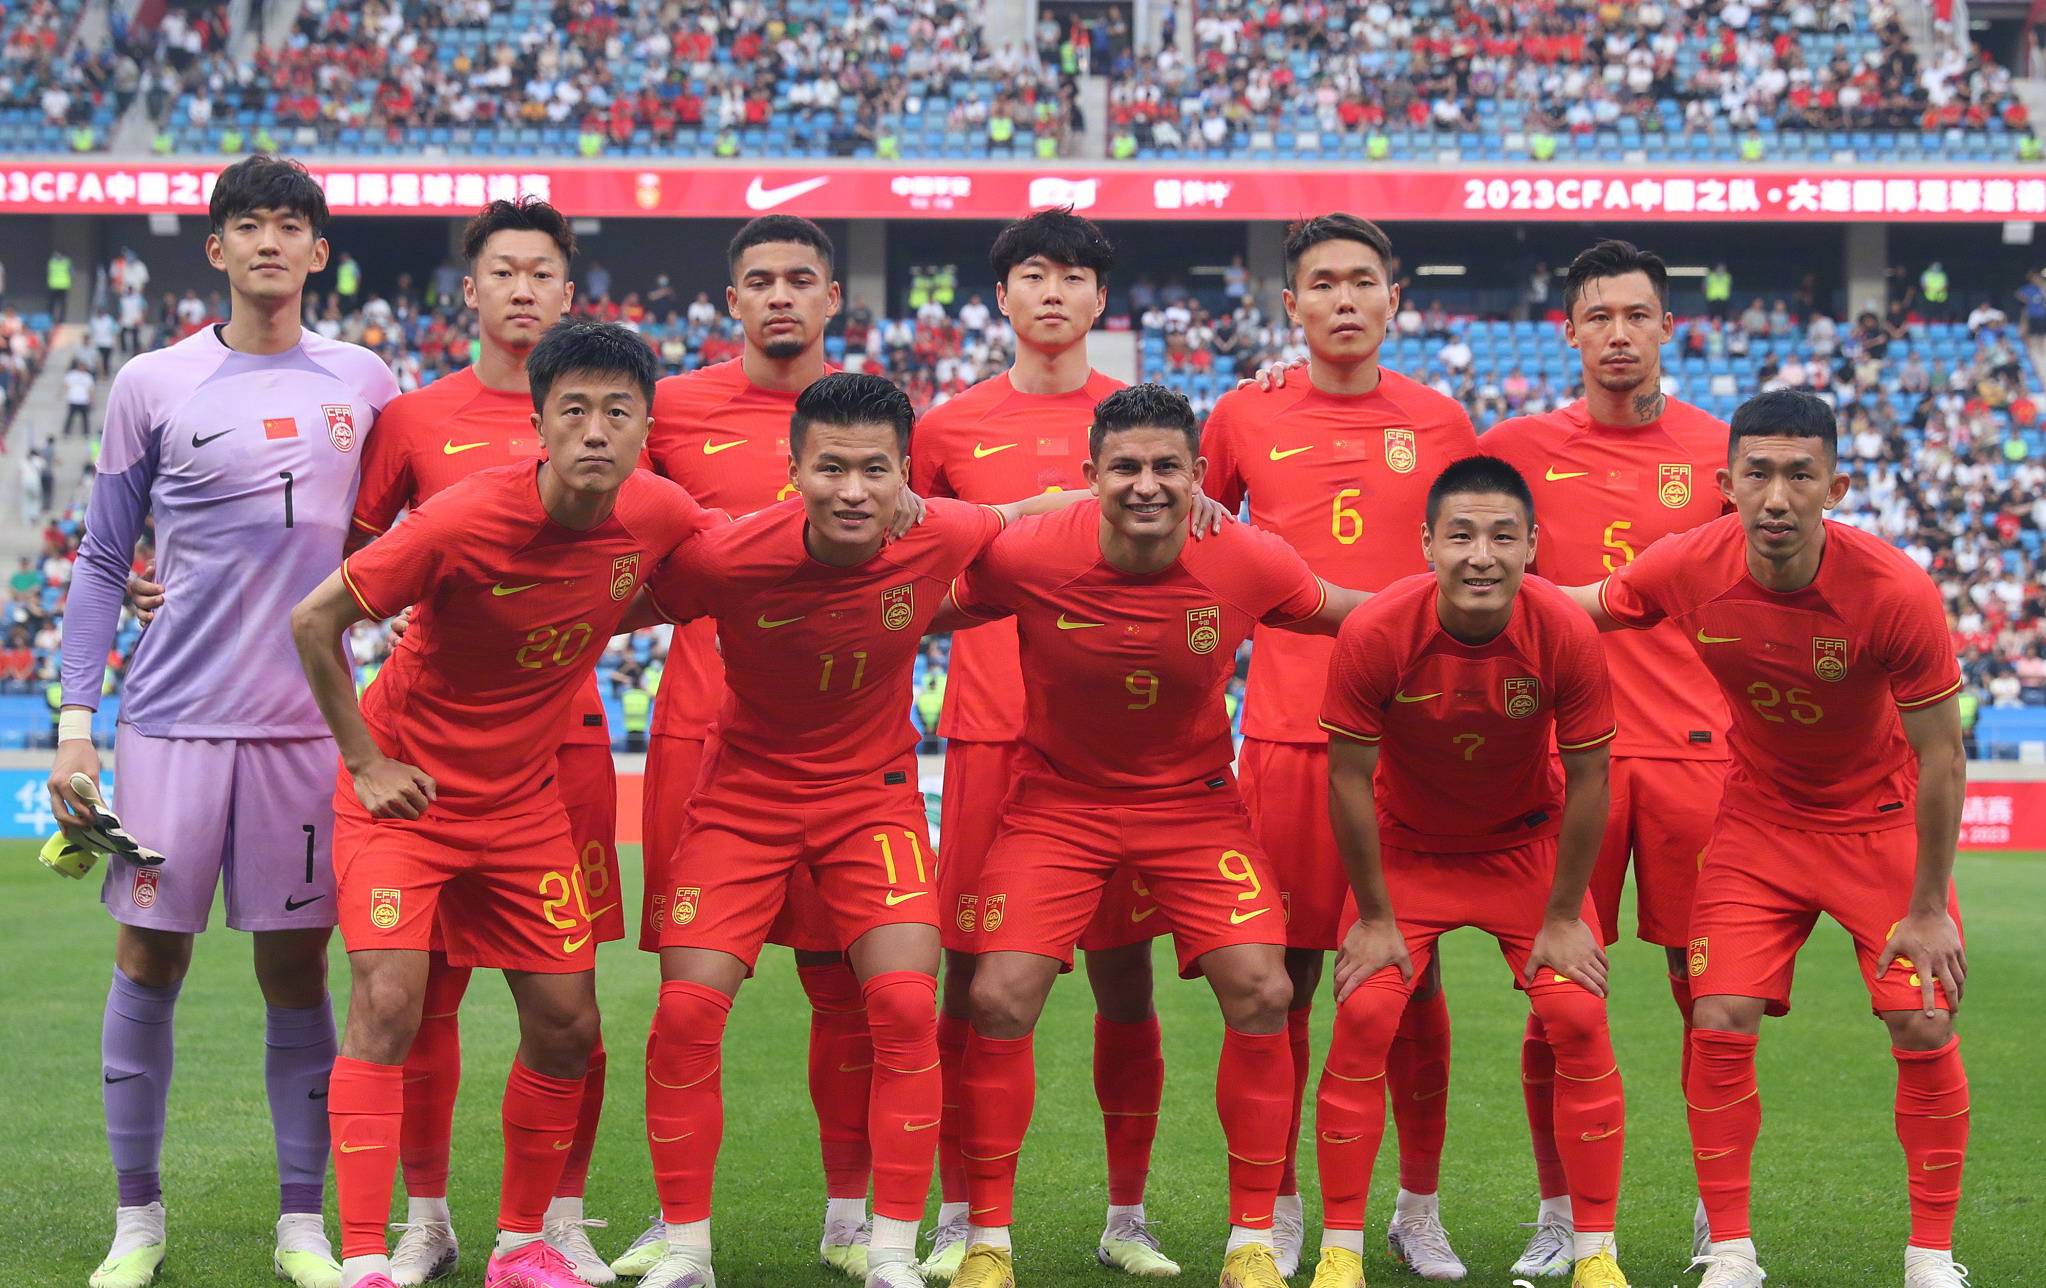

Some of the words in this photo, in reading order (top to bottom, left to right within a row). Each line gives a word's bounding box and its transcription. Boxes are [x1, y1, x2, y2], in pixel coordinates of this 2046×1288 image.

[279, 471, 293, 529] 1
[1331, 488, 1363, 545] 6
[1602, 521, 1635, 574] 5
[515, 622, 593, 669] 20
[819, 651, 867, 692] 11
[1125, 670, 1159, 710] 9
[1746, 681, 1824, 724] 25
[1453, 733, 1486, 761] 7
[303, 825, 315, 883] 1
[582, 839, 609, 898] 8
[873, 831, 926, 884] 11
[1217, 850, 1262, 901] 9
